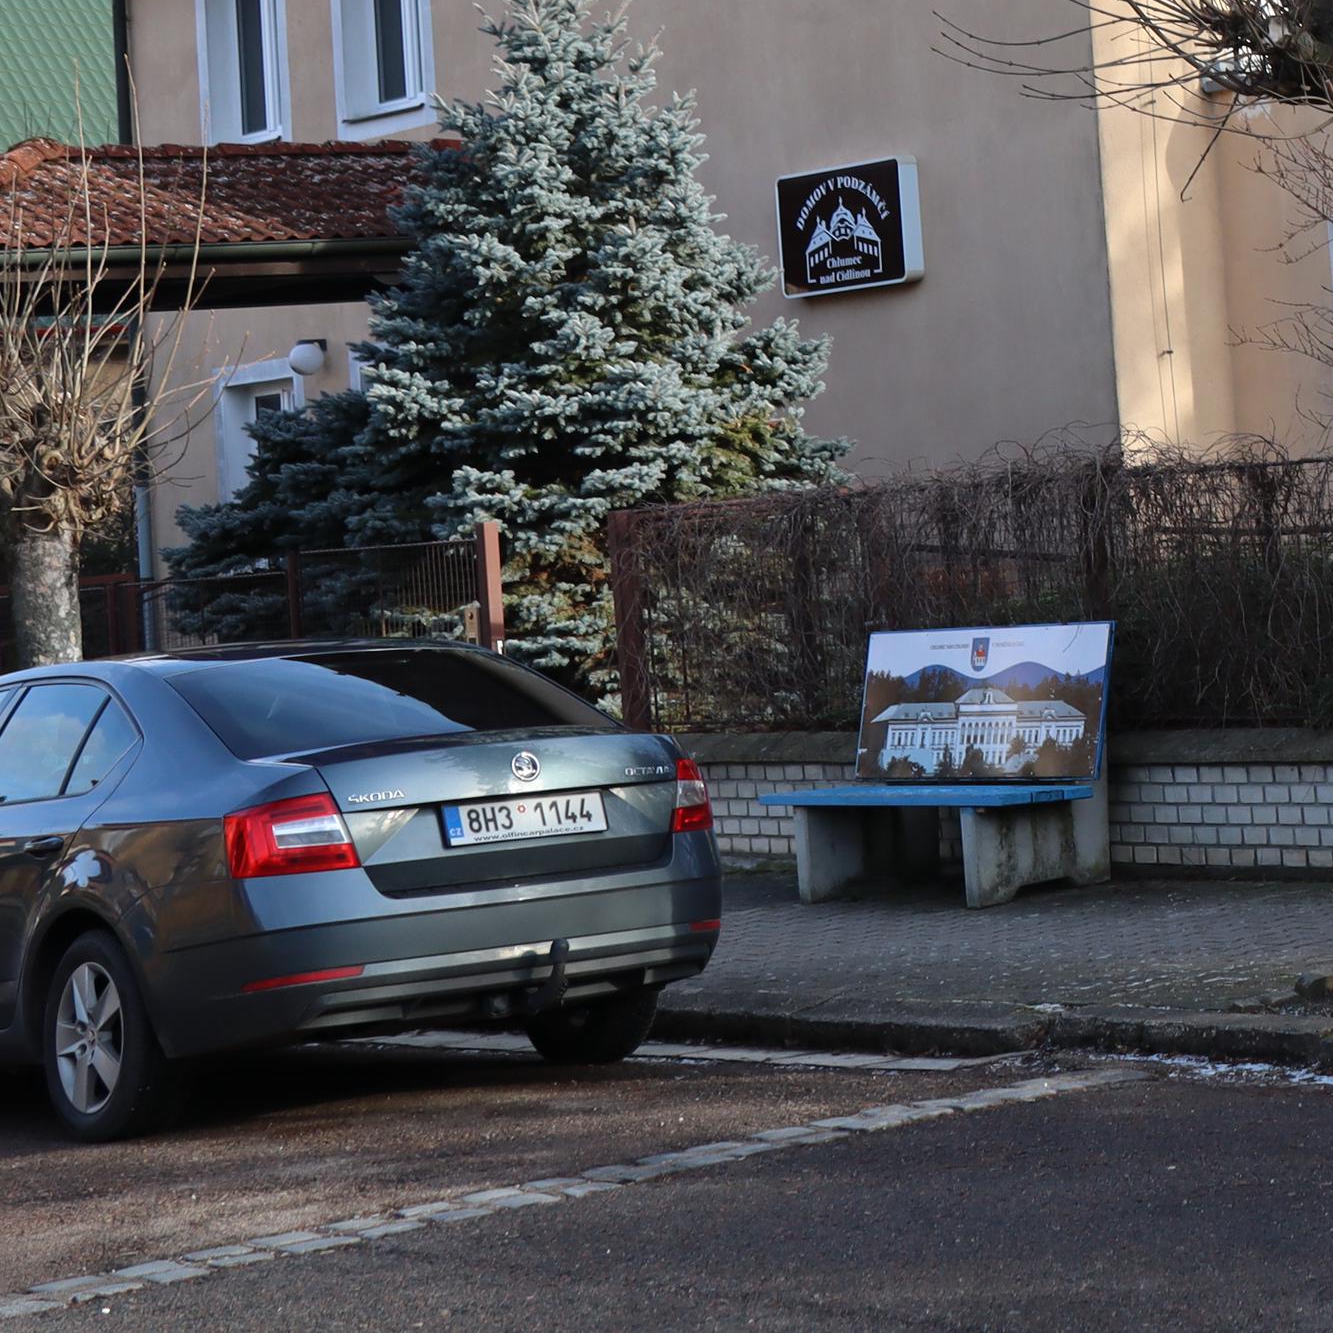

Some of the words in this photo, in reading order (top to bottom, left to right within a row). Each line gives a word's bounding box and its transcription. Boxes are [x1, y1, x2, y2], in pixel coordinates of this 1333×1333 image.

[796, 182, 828, 231] DOMOV
[827, 178, 836, 192] V
[836, 175, 890, 220] PODZÁMČÍ
[826, 255, 862, 269] Chlumec
[820, 272, 836, 284] nad
[836, 268, 870, 282] Cidlinou
[466, 806, 513, 834] 8H3
[534, 798, 592, 826] 1144
[450, 828, 462, 836] CZ
